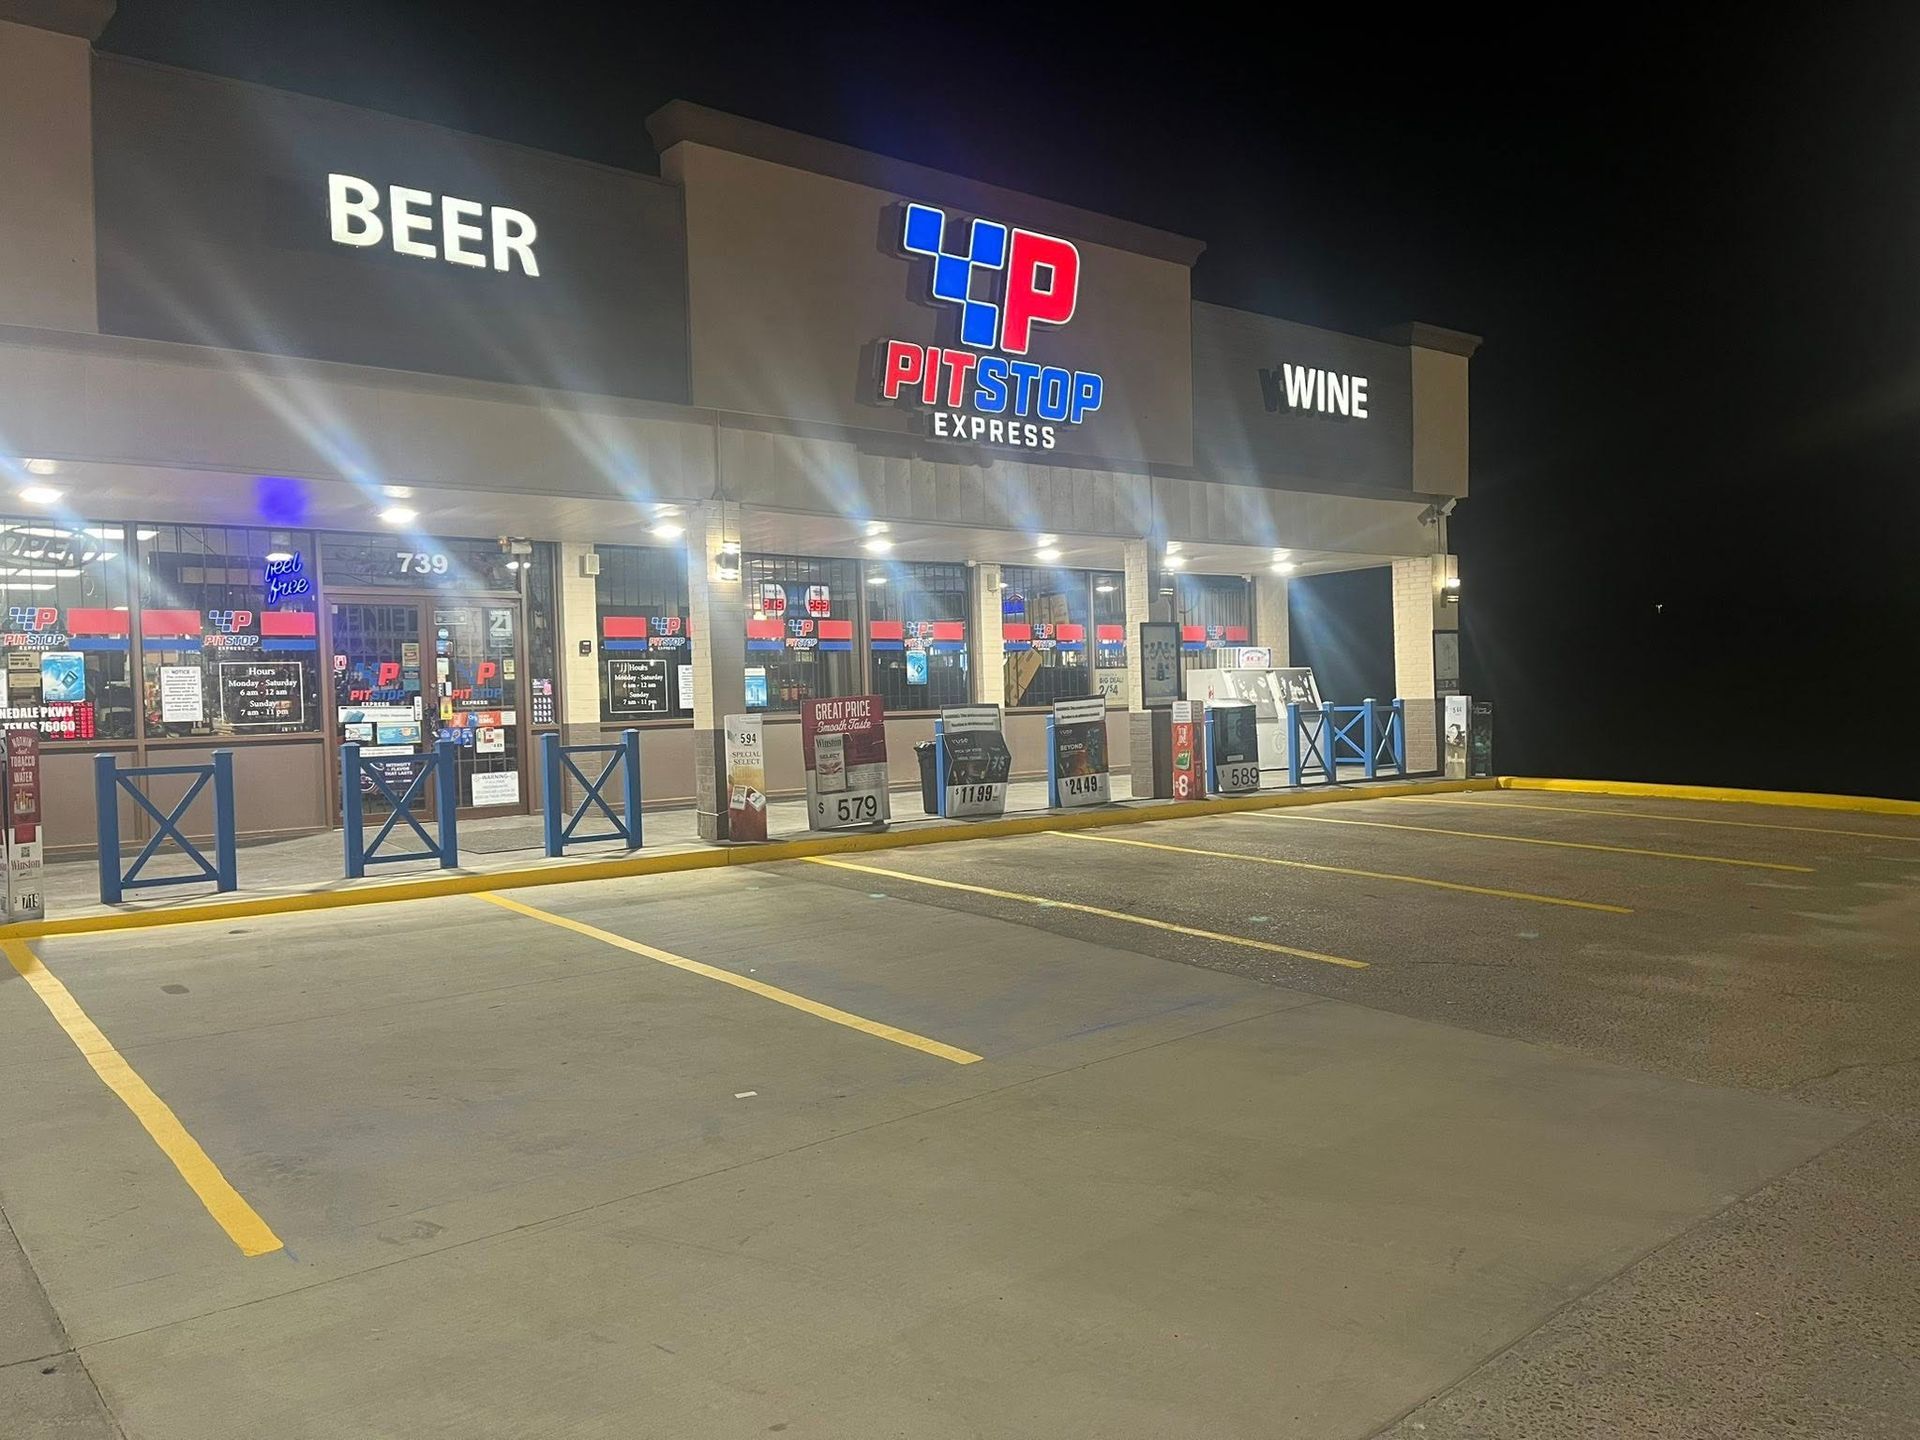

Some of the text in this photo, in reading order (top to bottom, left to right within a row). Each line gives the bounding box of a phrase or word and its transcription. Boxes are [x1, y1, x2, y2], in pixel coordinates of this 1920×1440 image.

[328, 173, 540, 277] BEER
[1000, 227, 1080, 355] P
[884, 340, 1103, 424] PITSTOP
[1283, 363, 1368, 418] WINE
[934, 412, 1055, 449] EXPRESS
[397, 552, 448, 574] 739
[268, 578, 309, 603] free
[4, 633, 65, 646] PITSTOP
[204, 635, 259, 646] PITSTOP
[249, 667, 276, 676] Hours
[228, 680, 259, 688] Monday
[265, 679, 298, 688] Saturday
[250, 700, 276, 709] Sunday
[815, 700, 871, 720] GREAT PRICE
[40, 706, 74, 718] PKWY
[3, 721, 75, 732] TEXAS 76060
[817, 719, 871, 733] Smooth Taste
[816, 738, 842, 749] Winston
[1060, 743, 1083, 751] BEYOND
[10, 755, 35, 768] TOBACCO
[13, 772, 33, 783] WATER
[837, 795, 877, 822] 5.79
